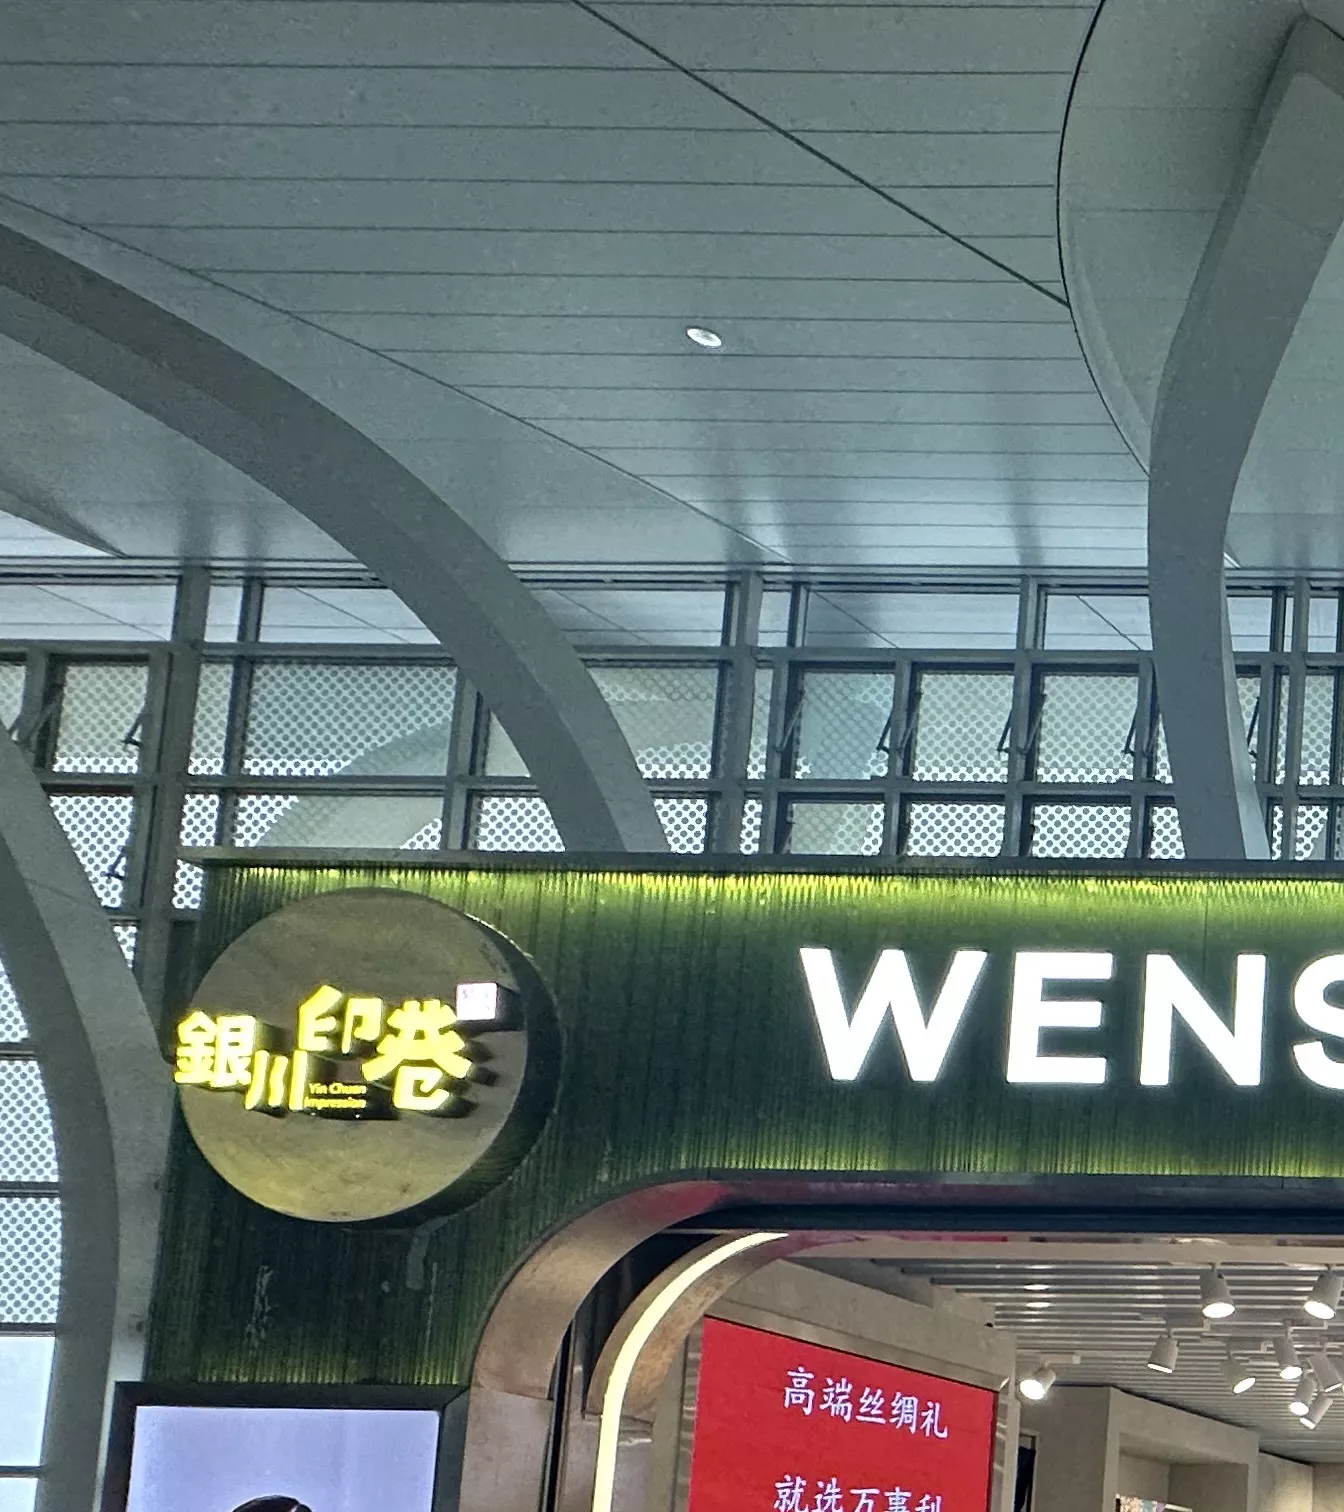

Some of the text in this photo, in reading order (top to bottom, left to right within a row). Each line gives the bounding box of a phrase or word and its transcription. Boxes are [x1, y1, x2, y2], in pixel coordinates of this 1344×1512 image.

[783, 1365, 949, 1438] 高端丝绸礼
